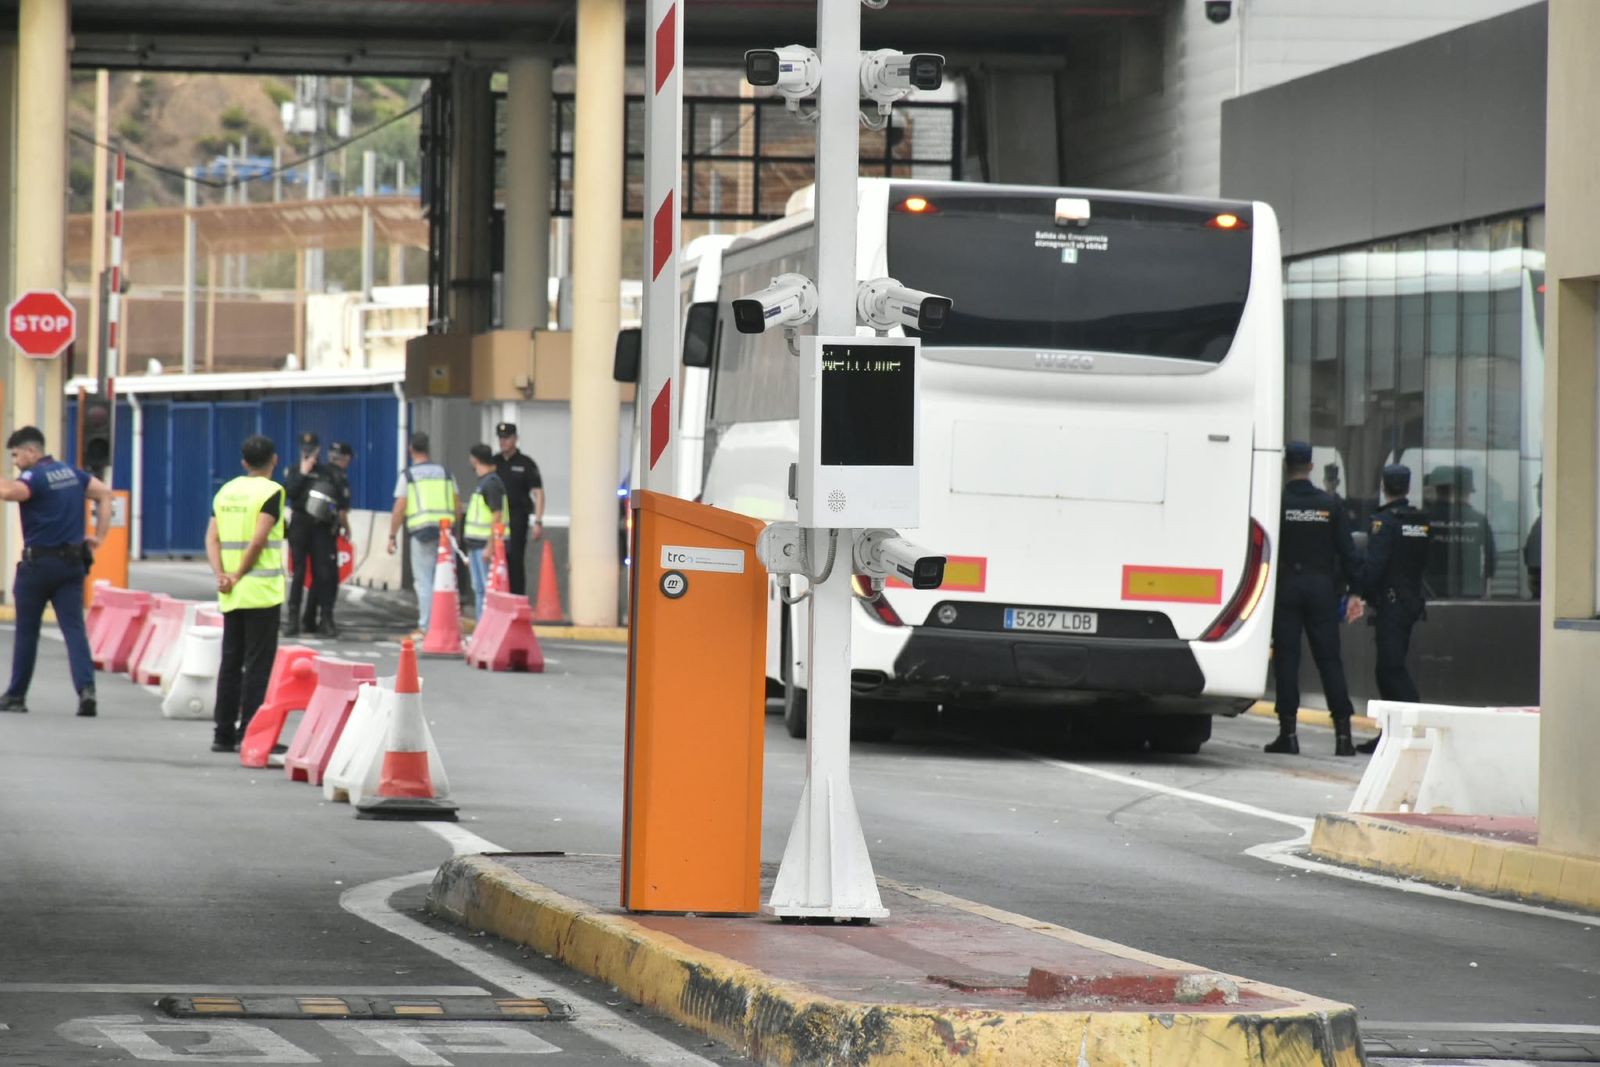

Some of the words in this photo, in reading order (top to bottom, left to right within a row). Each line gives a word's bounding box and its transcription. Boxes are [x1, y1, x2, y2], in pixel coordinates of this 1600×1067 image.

[14, 314, 69, 333] STOP
[1035, 352, 1094, 370] IVECO
[1016, 611, 1056, 628] 5287
[1062, 613, 1092, 630] LDB
